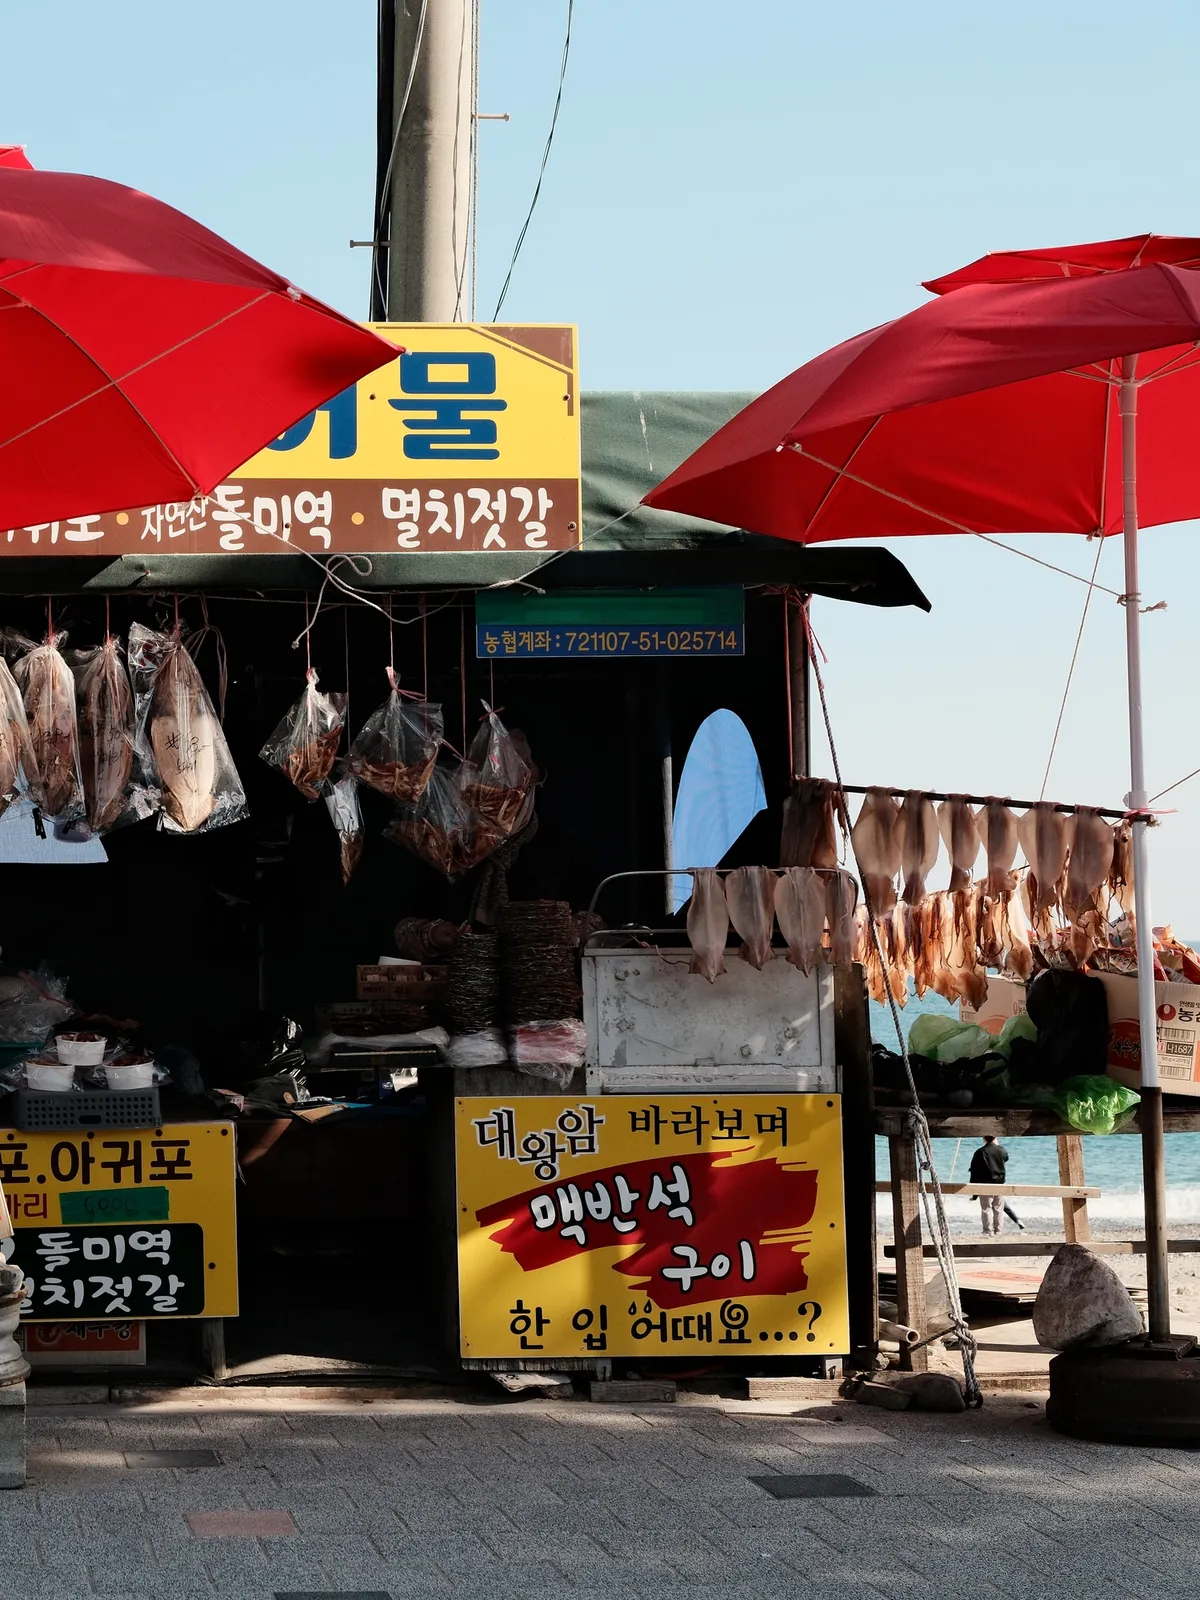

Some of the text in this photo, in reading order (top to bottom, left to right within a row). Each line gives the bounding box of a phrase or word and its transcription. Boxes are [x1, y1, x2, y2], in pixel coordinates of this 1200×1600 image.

[212, 485, 333, 551] 돌미역
[381, 486, 554, 550] 멸치젓갈
[474, 1104, 788, 1181] 대왕암 바라보며
[529, 1164, 695, 1246] 맥반석
[36, 1229, 172, 1272] 돌미역
[661, 1240, 756, 1293] 구이
[508, 1298, 551, 1351] 한
[571, 1303, 608, 1352] 입
